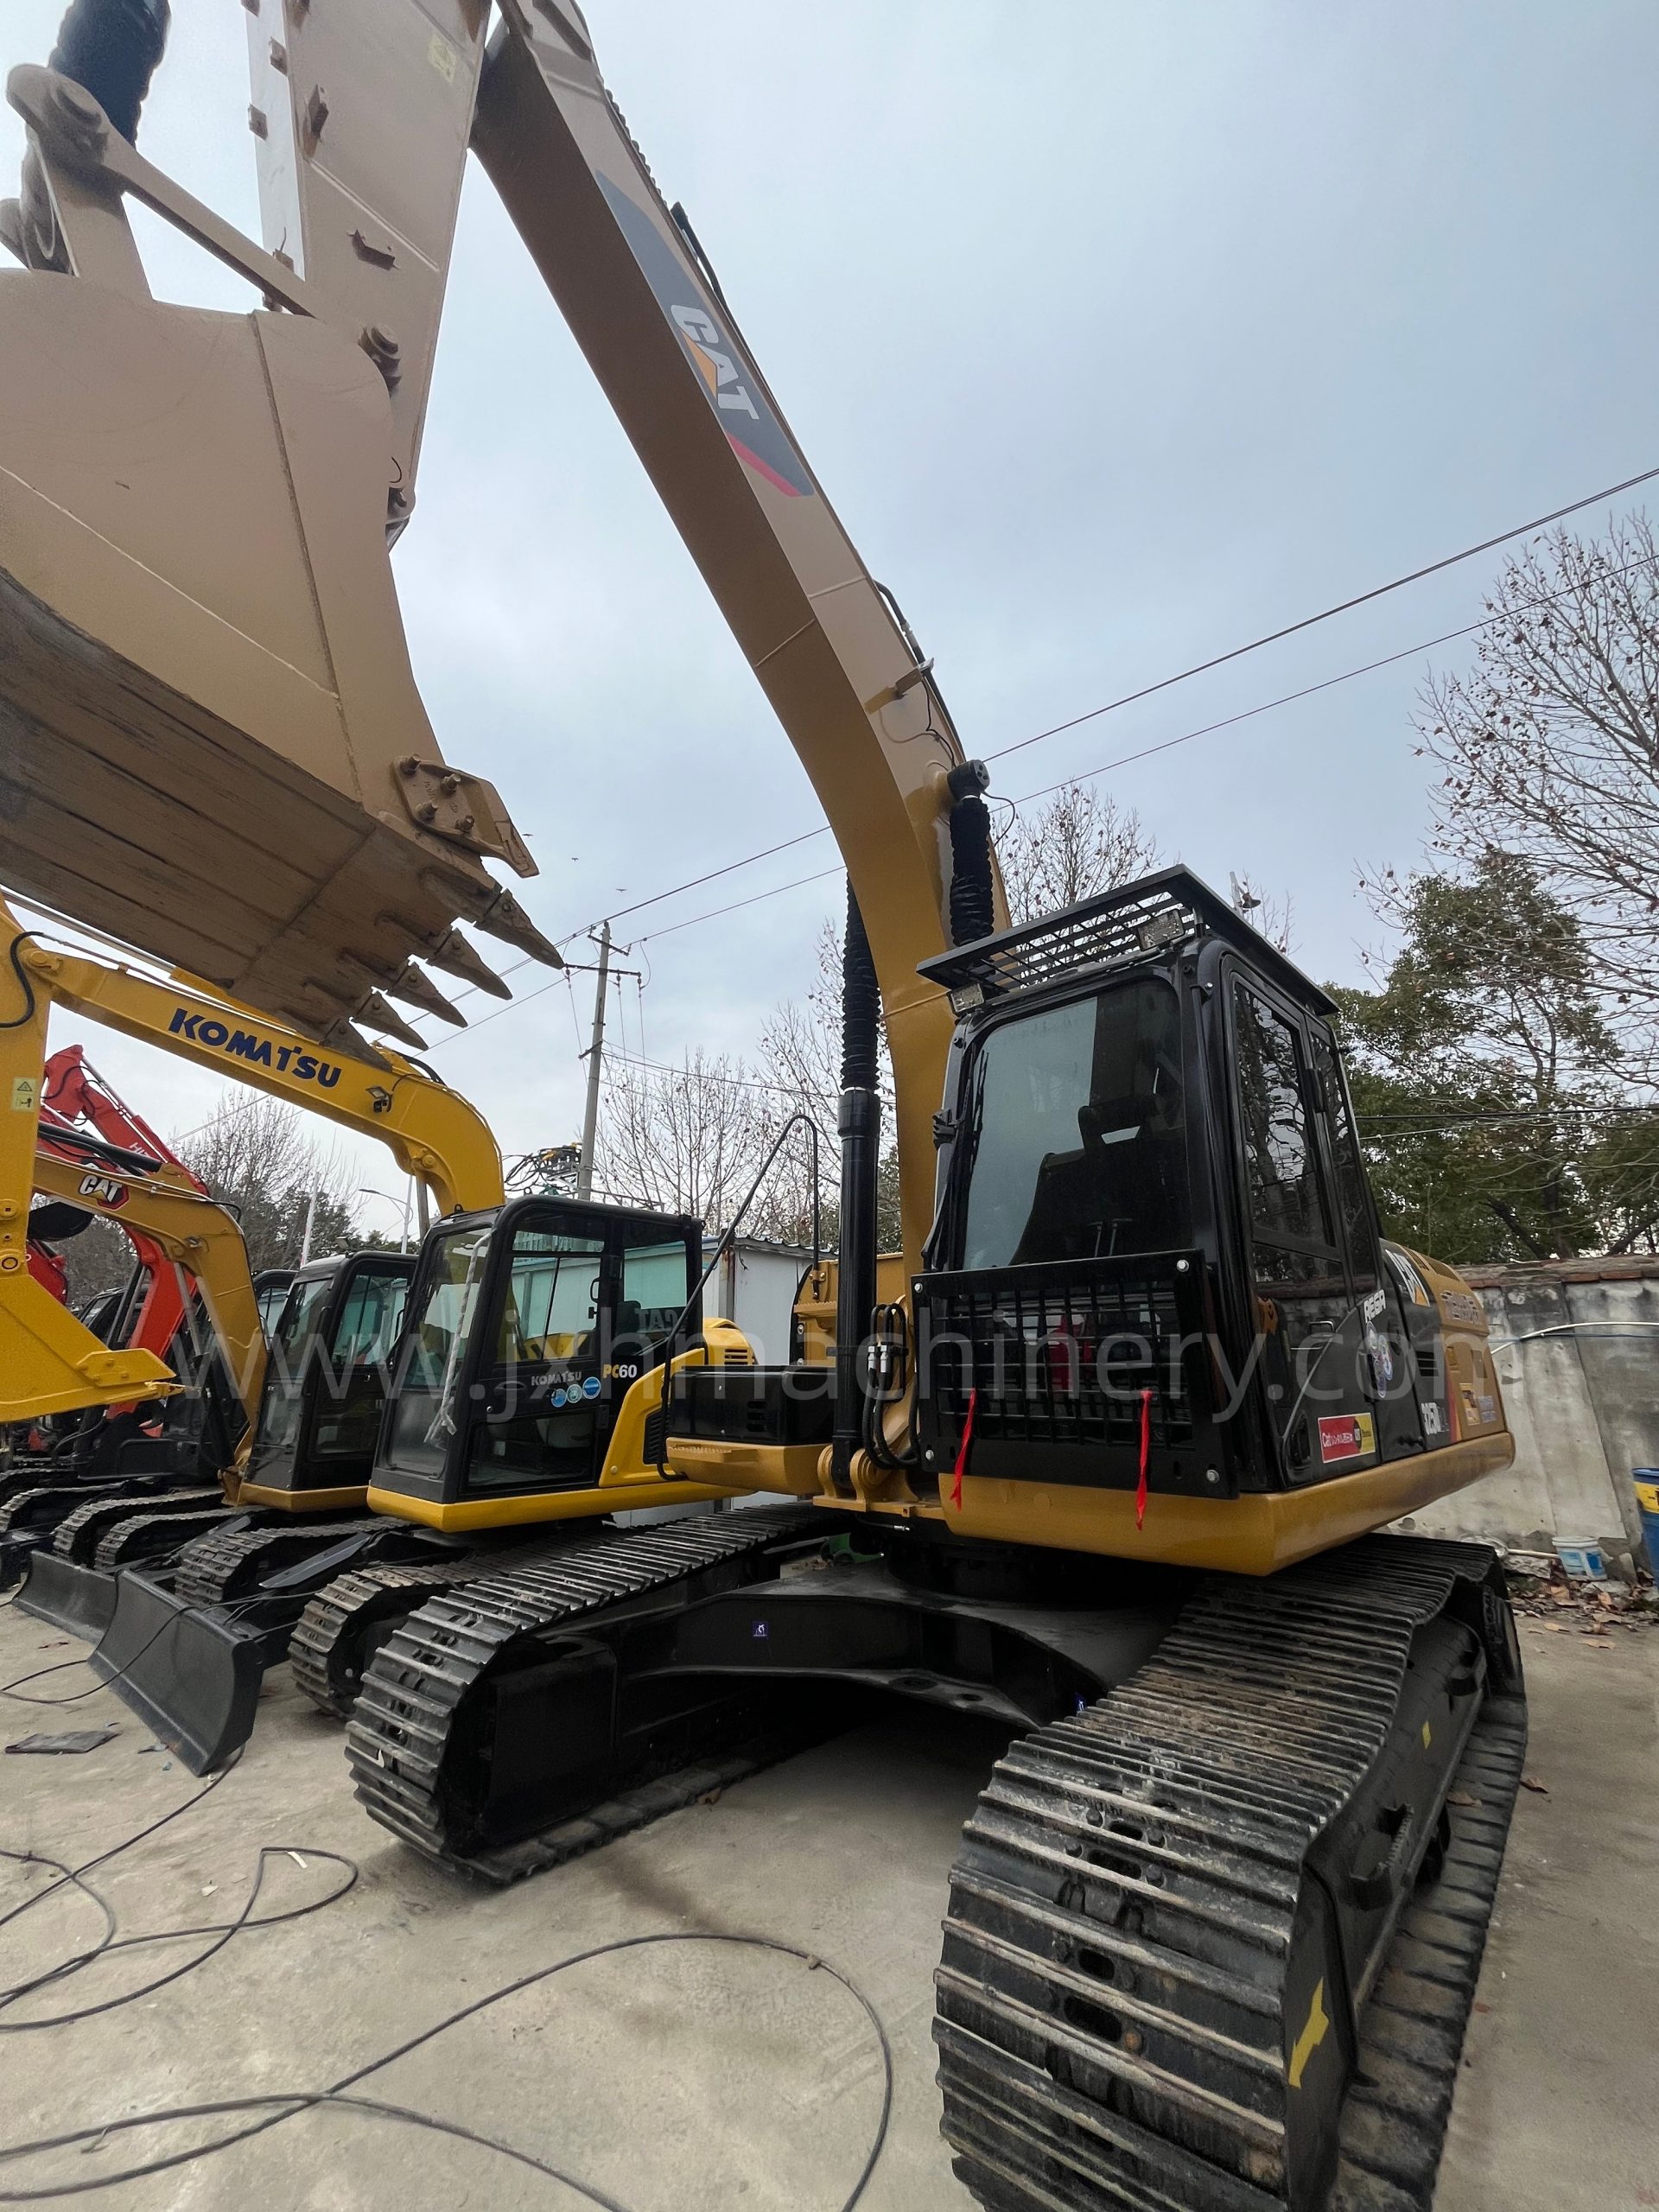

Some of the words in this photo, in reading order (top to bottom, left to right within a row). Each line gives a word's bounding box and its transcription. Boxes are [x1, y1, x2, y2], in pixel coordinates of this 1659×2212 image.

[671, 305, 760, 420] CAT
[168, 1007, 342, 1088] KOMATSU
[79, 1174, 123, 1203] CAT
[531, 1370, 583, 1386] KOMATSU
[603, 1363, 638, 1379] PC60
